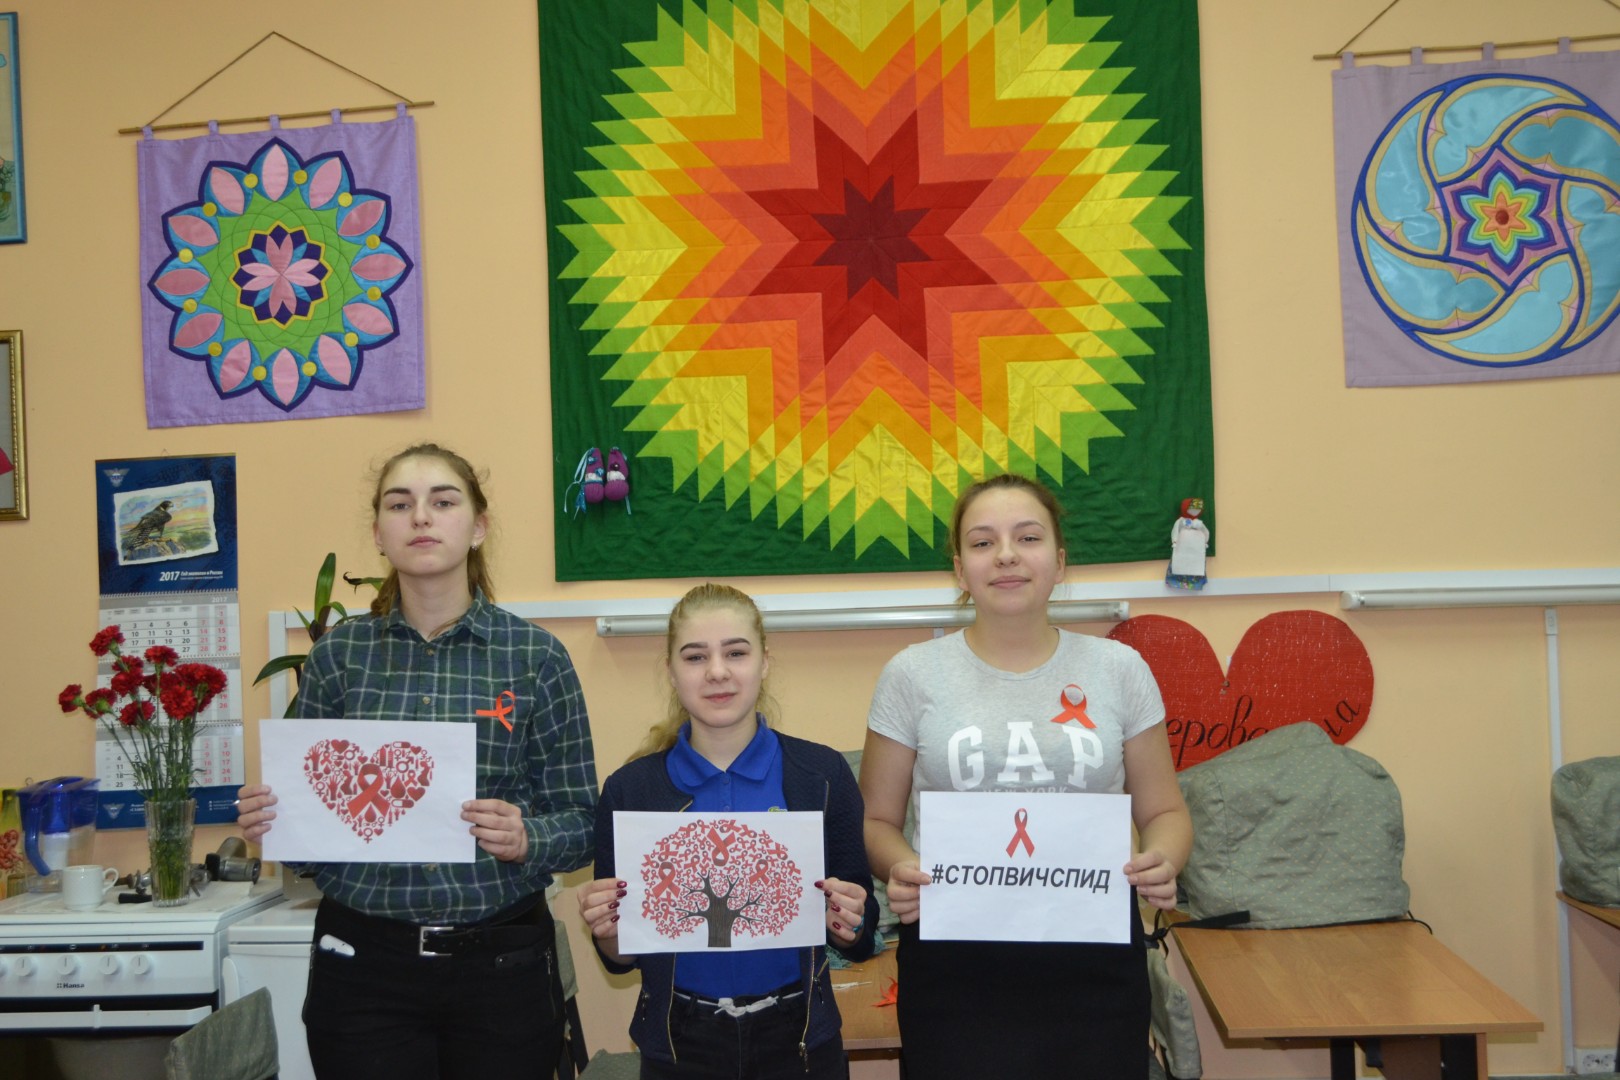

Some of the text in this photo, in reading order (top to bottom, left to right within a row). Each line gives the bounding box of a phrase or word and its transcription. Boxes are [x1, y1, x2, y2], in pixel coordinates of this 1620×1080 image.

[159, 571, 180, 581] 2017
[948, 721, 1103, 791] GAP
[931, 864, 1111, 894] #СТОПВИЧСПИД
